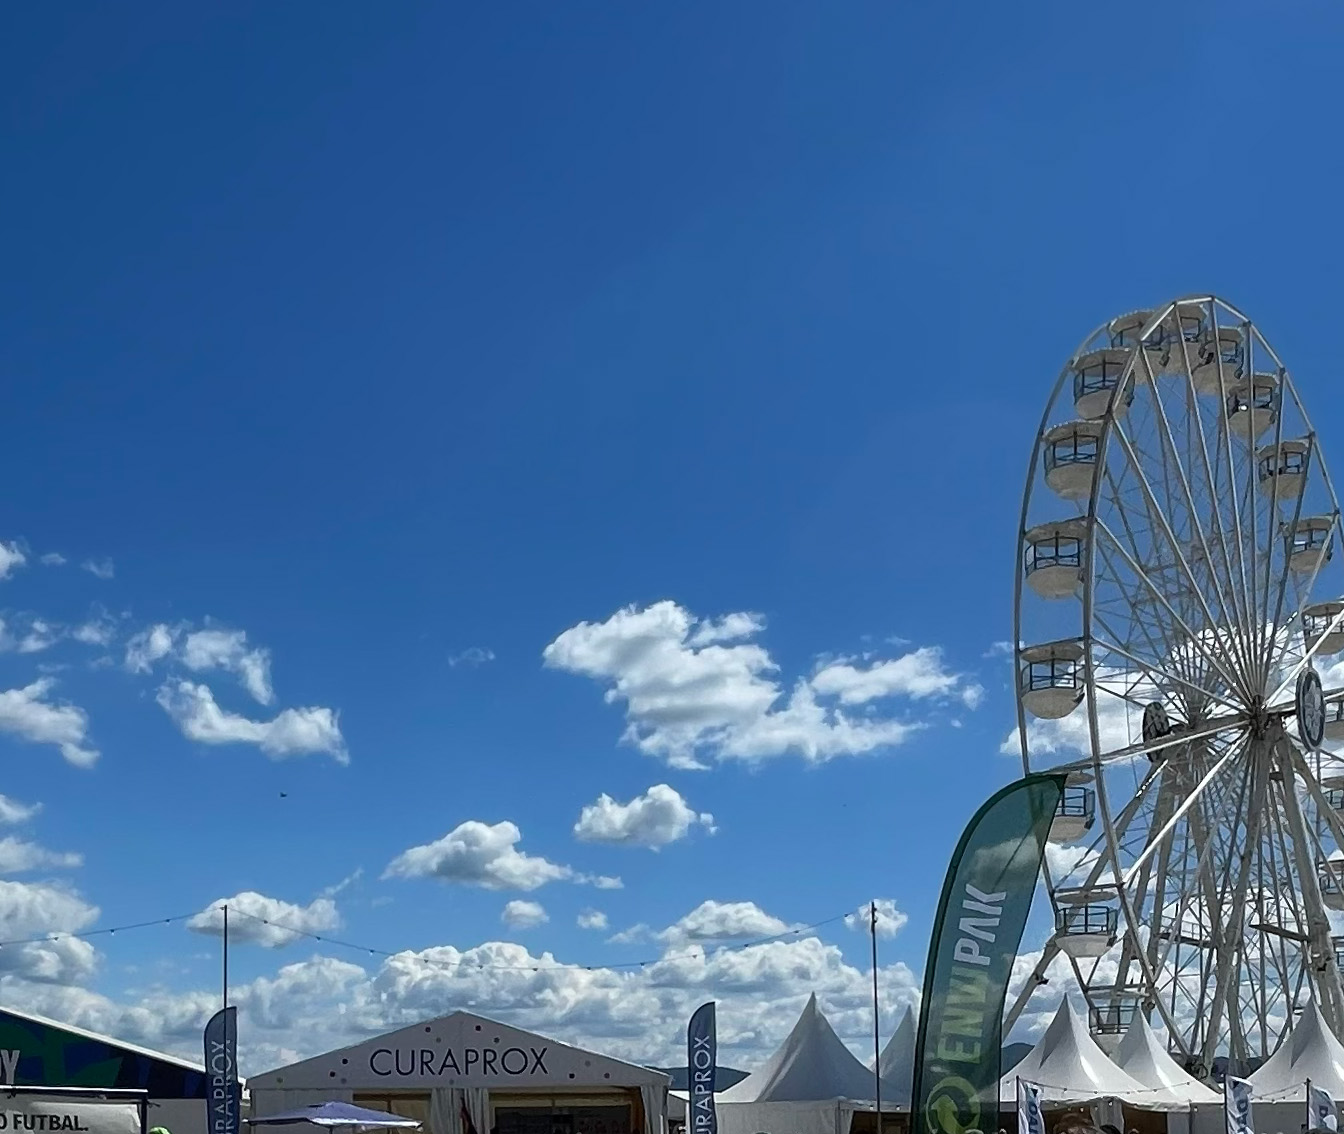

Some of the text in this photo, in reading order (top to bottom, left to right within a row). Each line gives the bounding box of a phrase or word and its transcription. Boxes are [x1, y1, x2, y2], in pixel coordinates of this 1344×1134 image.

[937, 883, 1006, 1064] ENVIPAK
[369, 1047, 549, 1076] CURAPROX
[13, 1113, 89, 1132] FUTBAL.
